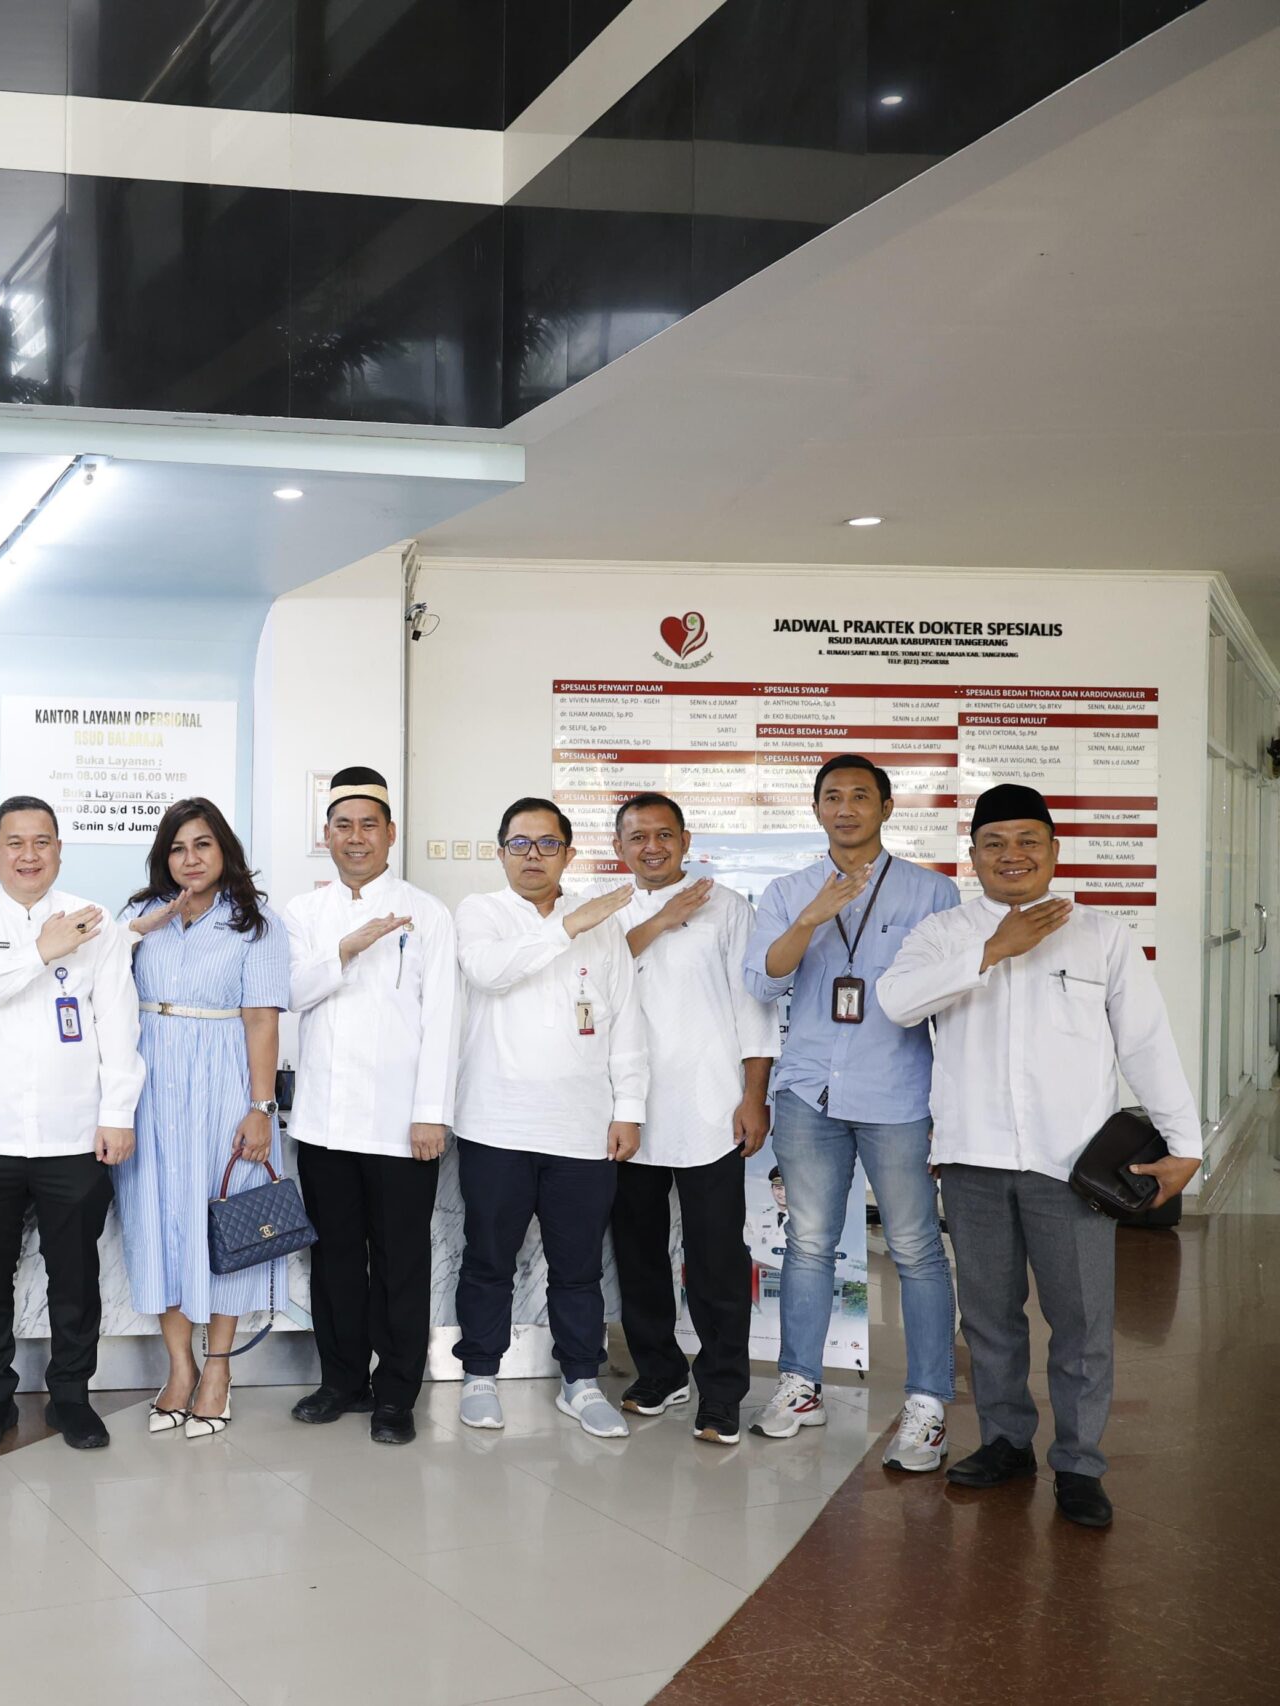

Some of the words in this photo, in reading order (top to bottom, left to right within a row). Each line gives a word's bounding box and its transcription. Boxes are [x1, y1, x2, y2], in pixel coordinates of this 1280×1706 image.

[773, 619, 839, 633] JADWAL
[843, 620, 915, 634] PRAKTEK
[919, 621, 983, 635] DOKTER
[987, 622, 1063, 637] SPESIALIS
[828, 636, 853, 645] RSUD
[854, 637, 899, 645] BALARAJA
[900, 637, 952, 646] KABUPATEN
[954, 638, 1008, 647] TANGERANG
[1062, 690, 1078, 698] DAN
[35, 709, 79, 724] KANTOR
[83, 710, 131, 726] LAYANAN
[135, 712, 203, 728] OPERSIONAL
[1020, 717, 1047, 725] MULUT
[74, 730, 104, 746] RSUD
[76, 755, 104, 765] Buka
[108, 756, 155, 767] Layanan
[49, 770, 73, 780] Jam
[78, 771, 107, 780] 08.00
[111, 772, 128, 781] s/d
[133, 772, 161, 782] 16.00
[165, 773, 187, 782] WIB
[63, 788, 91, 798] Buka
[95, 789, 142, 801] Layanan
[146, 790, 166, 799] Kas
[77, 804, 106, 814] 08.00
[110, 805, 127, 814] s/d
[132, 806, 160, 815] 15.00
[72, 821, 103, 831] Senin
[108, 822, 124, 831] s/d
[128, 823, 158, 832] Juma
[597, 863, 618, 871] KULIT
